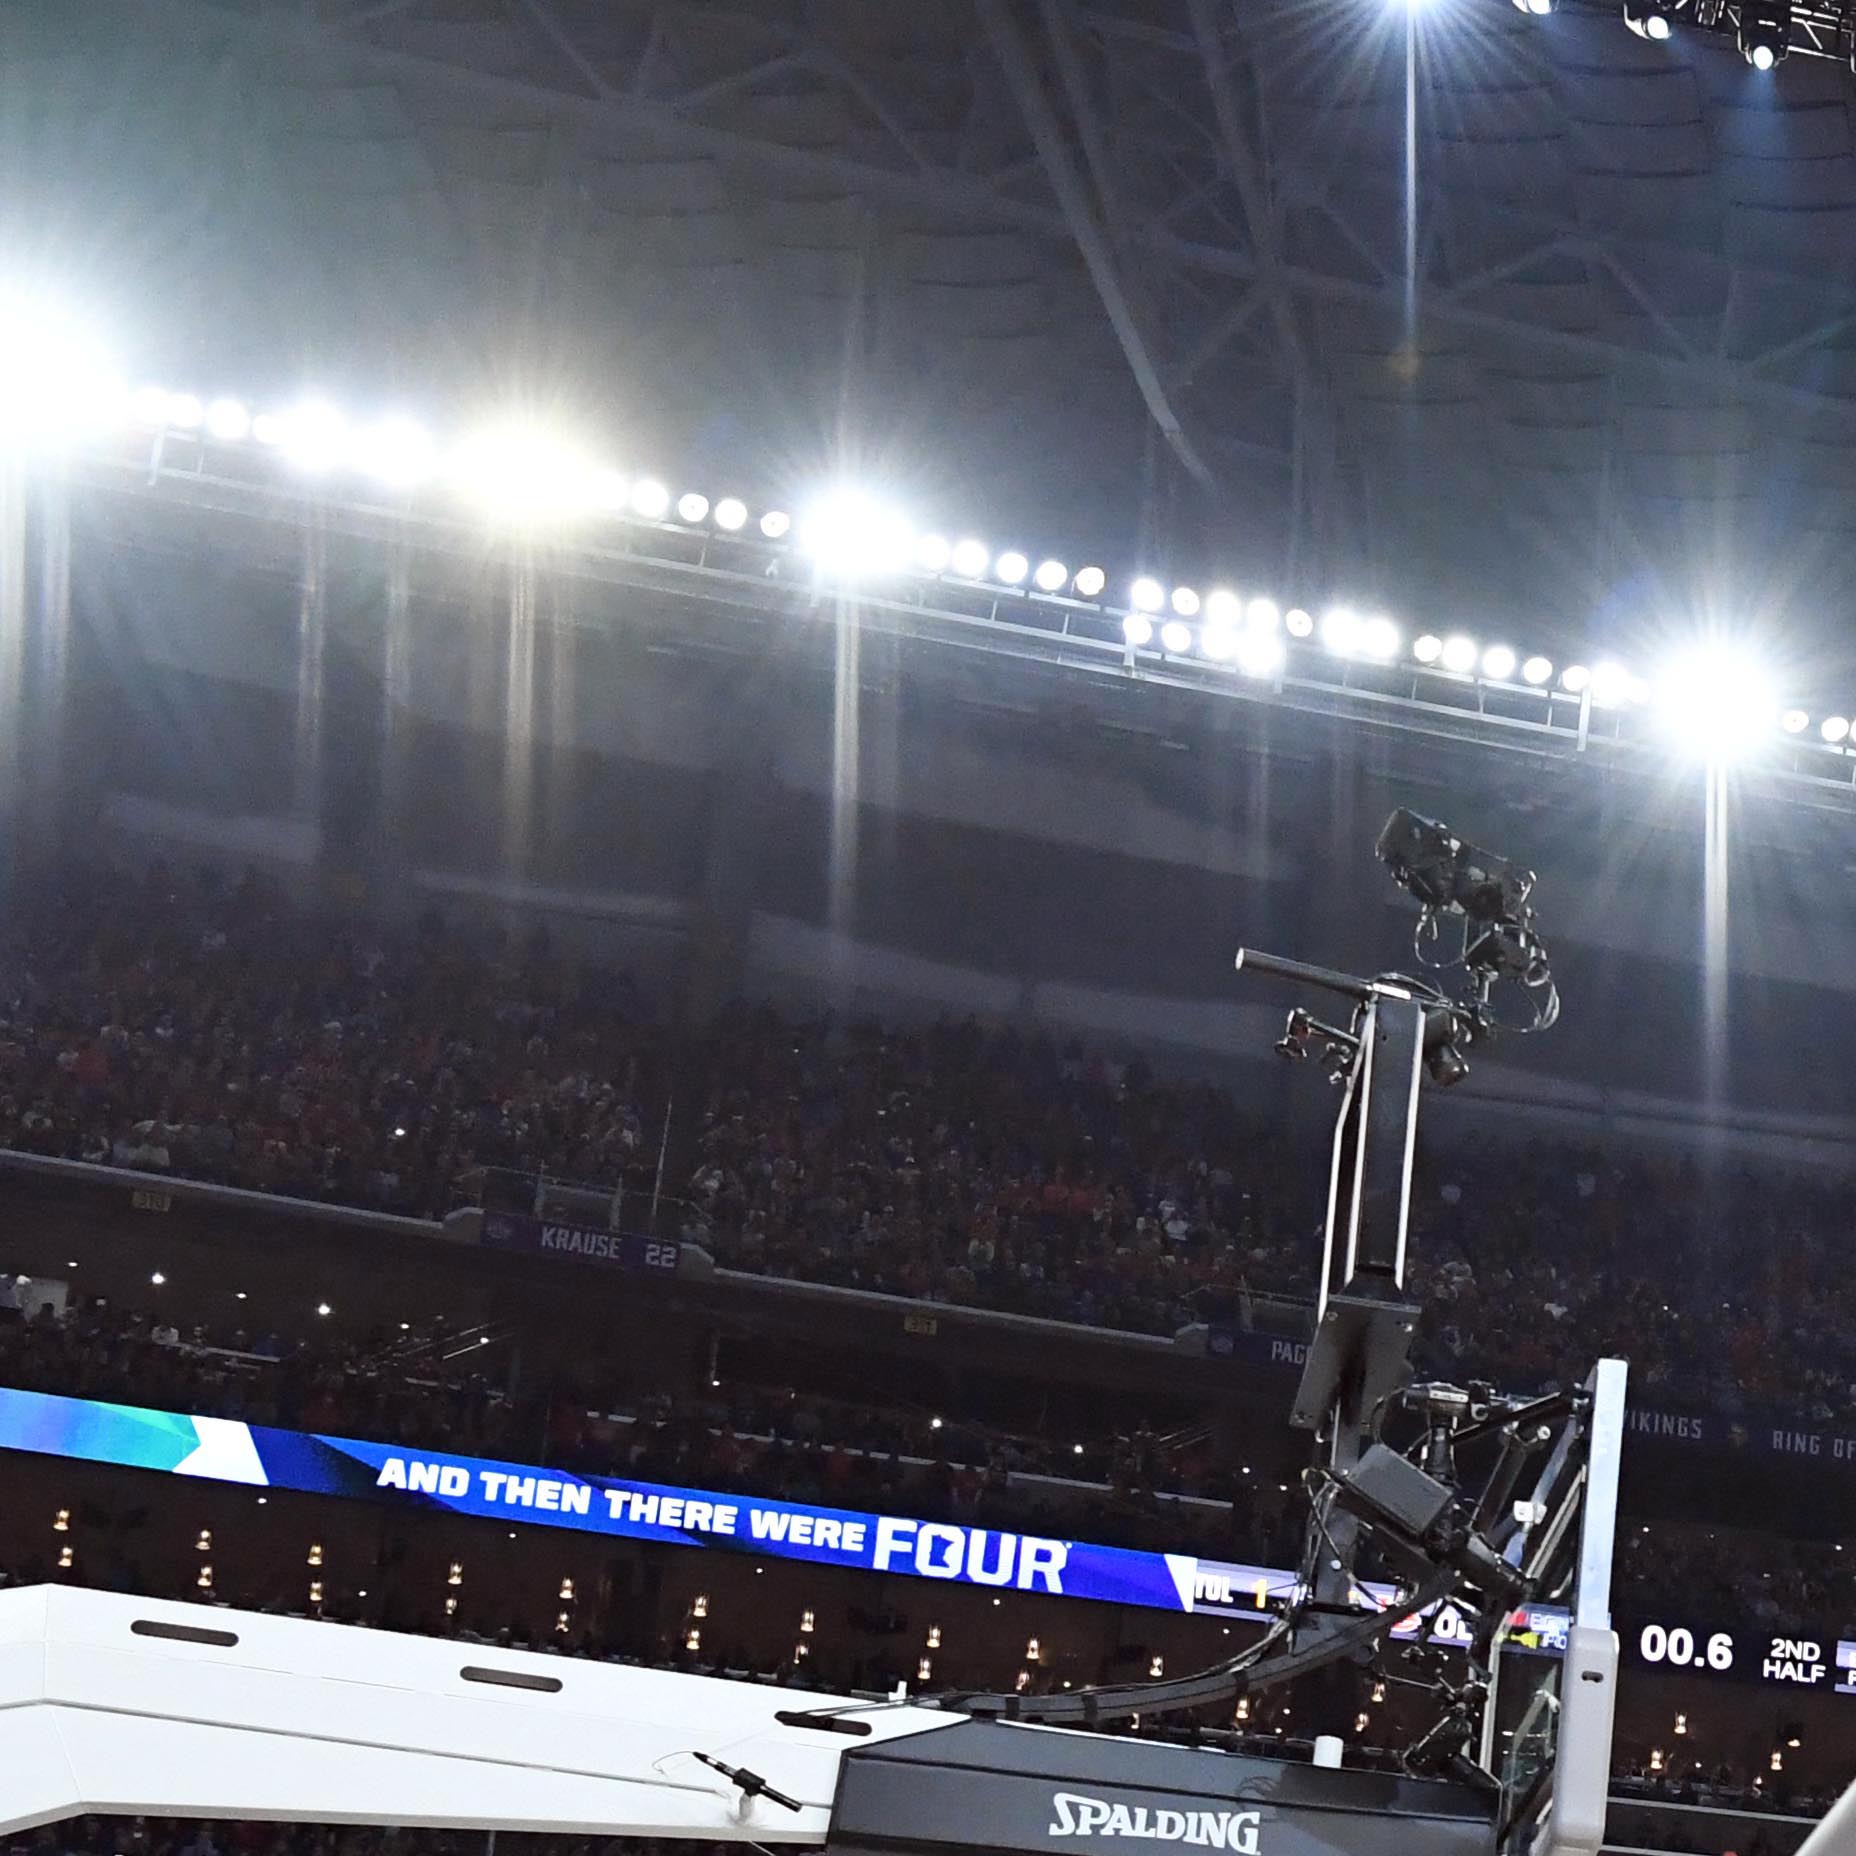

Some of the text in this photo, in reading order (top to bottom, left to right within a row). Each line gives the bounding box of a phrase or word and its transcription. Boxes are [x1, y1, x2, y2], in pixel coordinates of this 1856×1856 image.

[541, 1225, 677, 1269] KRAUSE 22
[1772, 1429, 1821, 1456] RING
[1833, 1437, 1856, 1460] OF
[376, 1457, 1068, 1595] AND THEN THERE WERE FOUR
[1639, 1624, 1734, 1671] 00.6
[1770, 1638, 1821, 1663] 2ND
[1762, 1658, 1827, 1685] HALF
[1048, 1792, 1262, 1856] SPALDING
